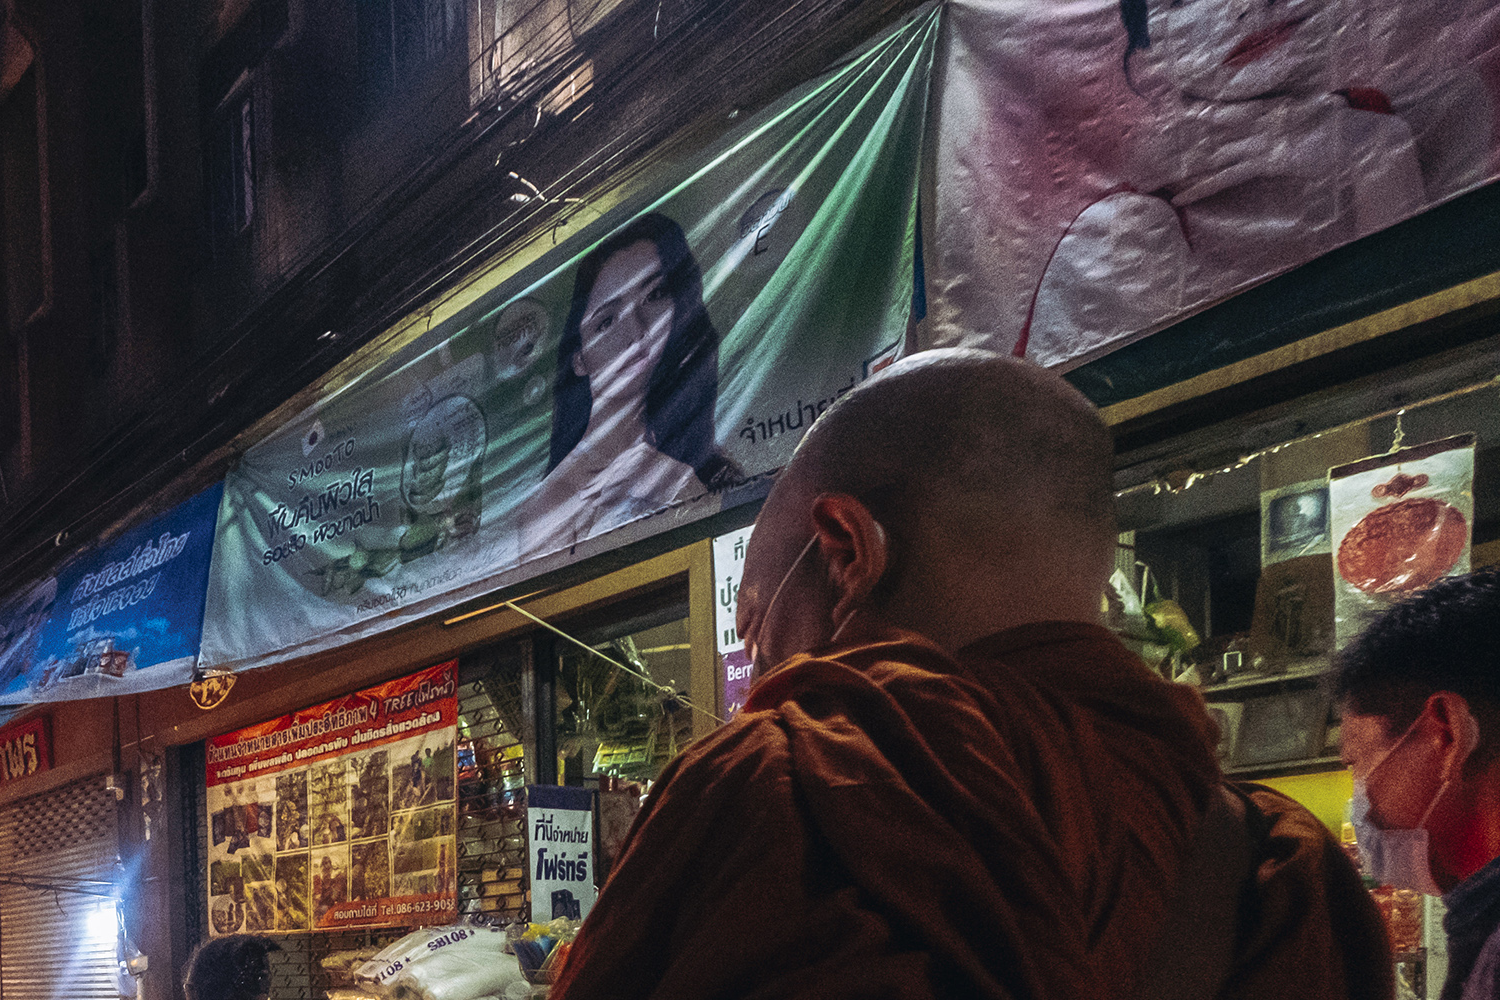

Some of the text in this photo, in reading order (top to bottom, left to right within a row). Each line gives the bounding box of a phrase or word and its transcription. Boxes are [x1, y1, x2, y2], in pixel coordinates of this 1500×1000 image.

[287, 437, 356, 490] SMOOTO
[535, 848, 588, 882] โฟร์ทรี
[427, 928, 469, 951] SB108
